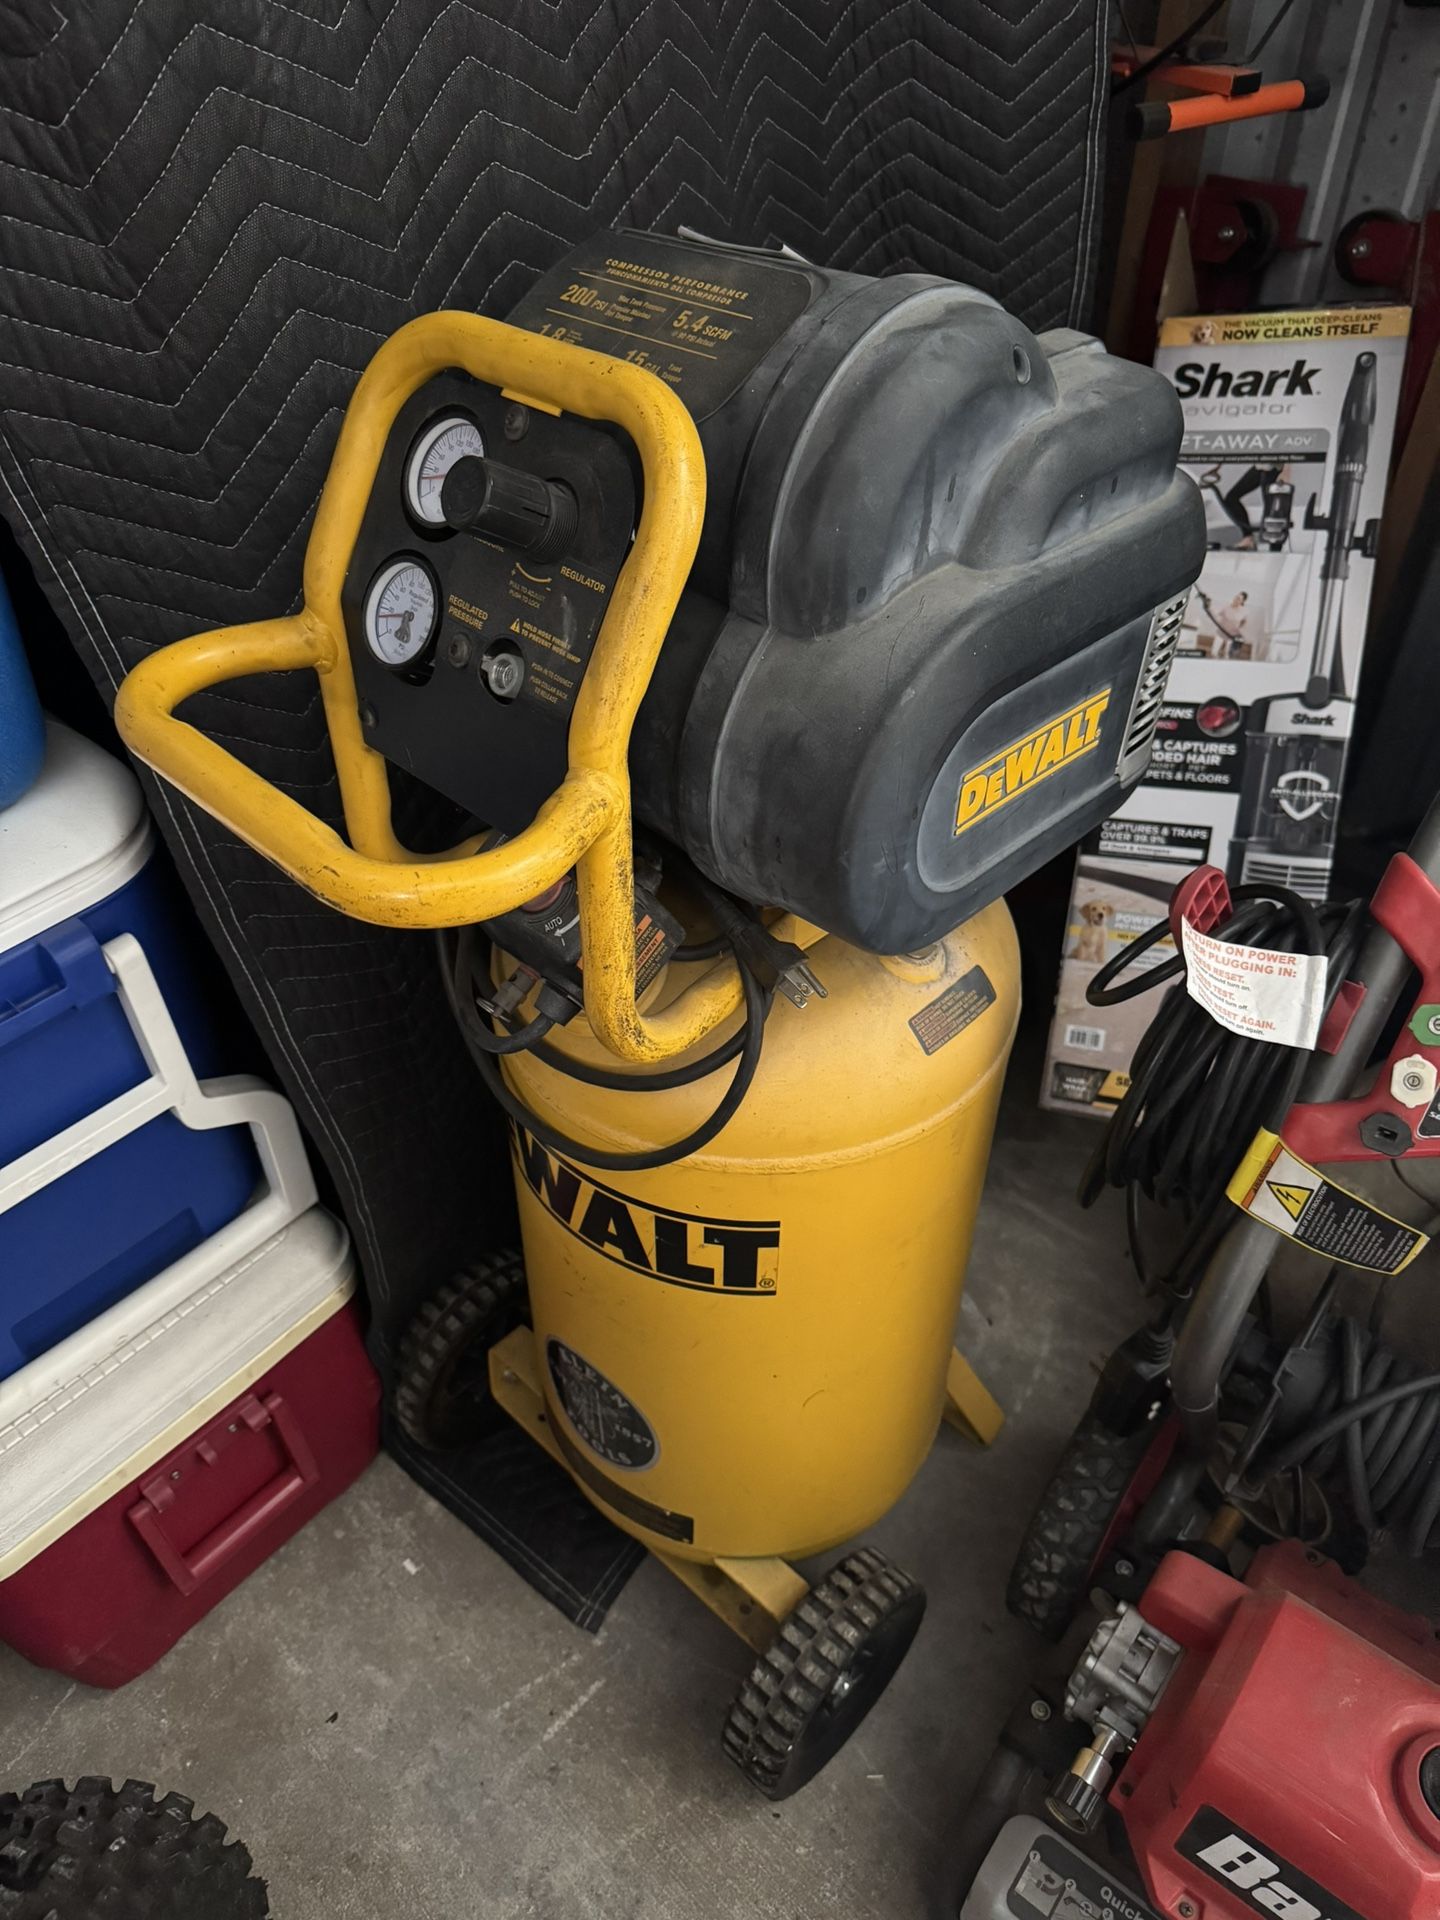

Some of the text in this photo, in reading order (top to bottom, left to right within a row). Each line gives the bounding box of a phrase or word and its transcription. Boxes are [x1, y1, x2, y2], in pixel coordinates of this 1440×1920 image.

[605, 258, 749, 300] COMPRESSOR PERFORMANCE
[606, 268, 669, 288] FUNCIONAMIENTO
[560, 284, 609, 311] 200 PSI
[673, 310, 733, 341] 5.4 SCFM
[1244, 318, 1285, 328] VACUUM
[1288, 316, 1311, 325] THAT
[1313, 313, 1382, 324] DEEP-CLEANS
[1222, 323, 1379, 341] NOW CLEANS ITSELF
[624, 350, 649, 366] 15
[1175, 359, 1323, 399] Shark
[1184, 402, 1297, 418] avigator
[1181, 433, 1313, 451] FT-AWAY ADV
[560, 565, 607, 594] REGULATOR
[449, 594, 489, 621] REGULATED
[448, 606, 484, 630] PRESSURE
[523, 621, 538, 633] HOLD
[521, 629, 529, 637] TO
[1160, 708, 1194, 719] FINS
[1290, 713, 1335, 727] Shark
[1163, 740, 1238, 756] CAPTURES
[1152, 751, 1222, 766] DED HAIR
[1146, 769, 1231, 785] PETS & FLOORS
[1100, 831, 1131, 842] OVER
[1101, 821, 1209, 840] CAPTURES & TRAPS
[544, 916, 563, 933] AUTO
[1193, 931, 1221, 953] TURN
[1225, 946, 1245, 958] ON
[1248, 949, 1297, 965] POWER
[1207, 951, 1274, 975] PLUGGING
[1278, 966, 1297, 978] IN:
[1213, 966, 1245, 984] RESET.
[1213, 984, 1235, 1001] TEST.
[1240, 1015, 1276, 1031] AGAIN.
[516, 1121, 780, 1288] WALT
[1305, 1185, 1328, 1221] ELECTROCUTION
[1196, 1833, 1330, 1920] Ba
